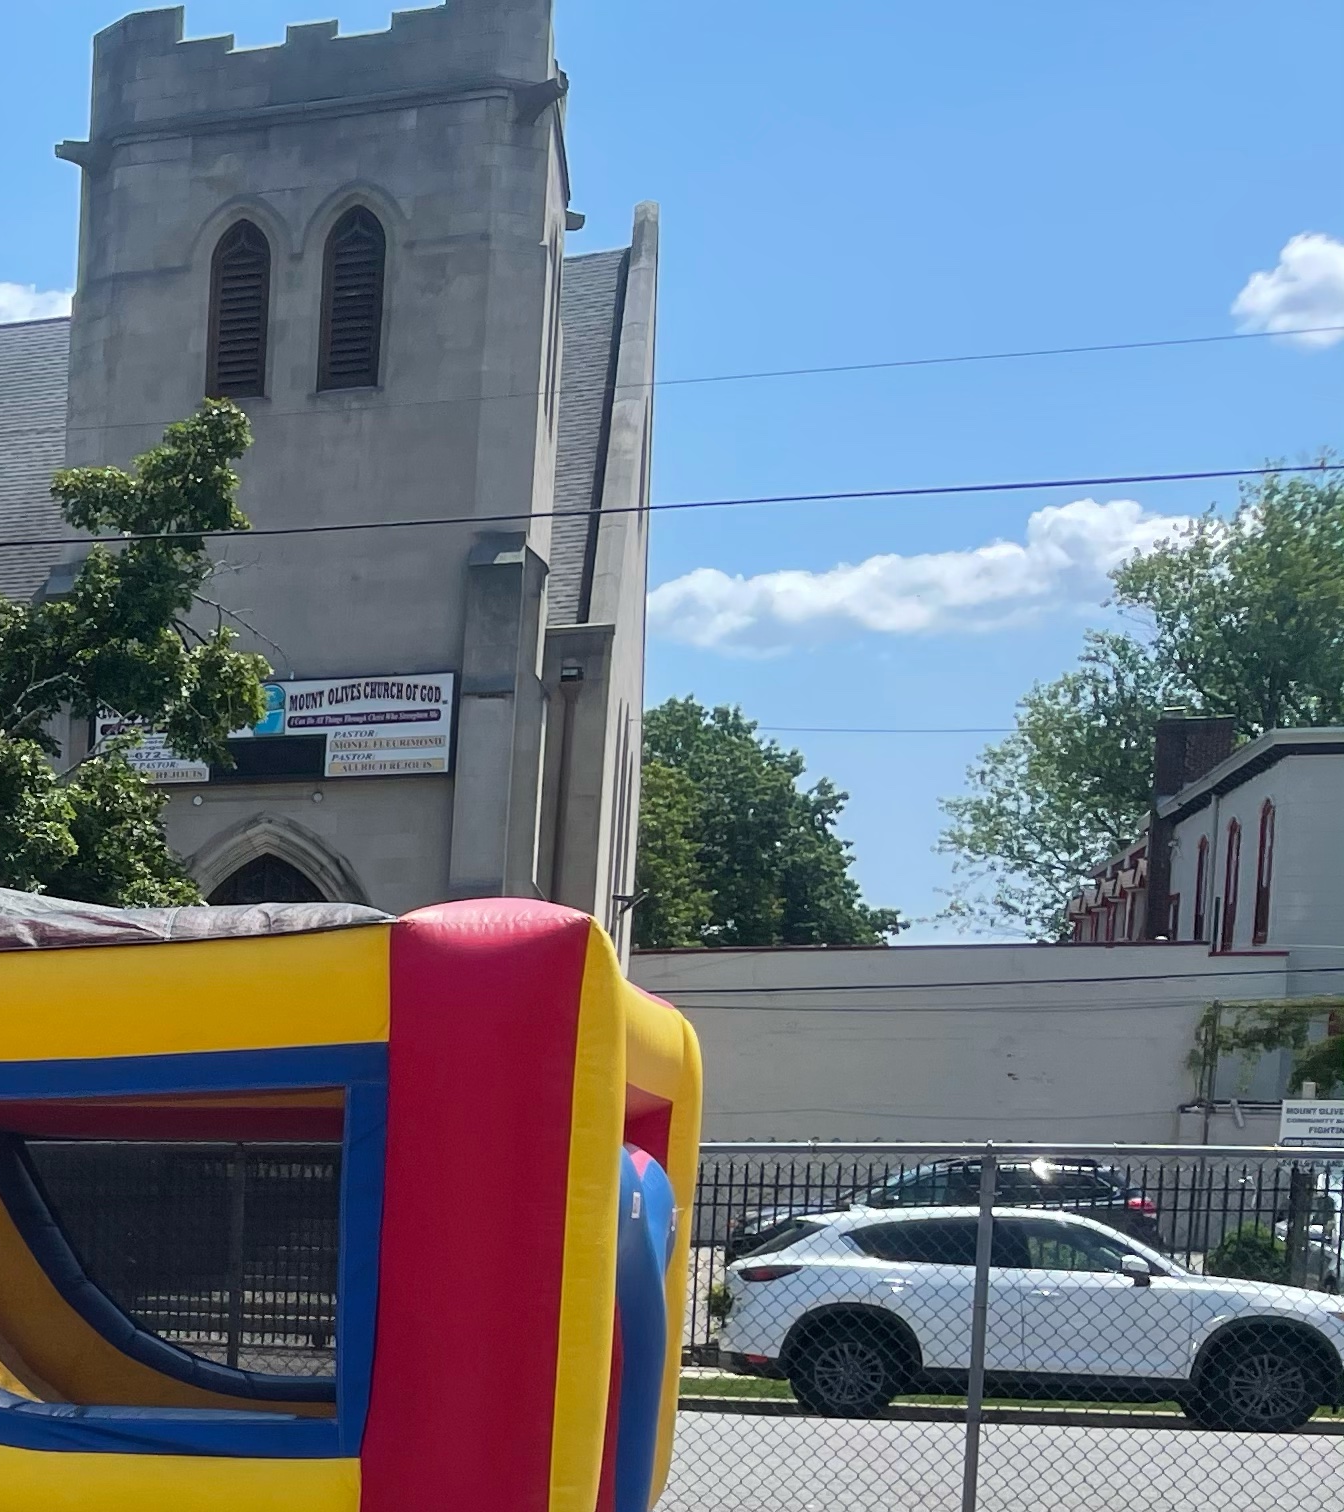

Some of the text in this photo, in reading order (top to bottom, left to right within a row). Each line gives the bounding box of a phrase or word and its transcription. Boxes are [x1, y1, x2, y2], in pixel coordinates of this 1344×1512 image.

[289, 681, 442, 711] MOUNT OLIVES CHURCH OF GOD
[1286, 1107, 1317, 1115] MOUNT
